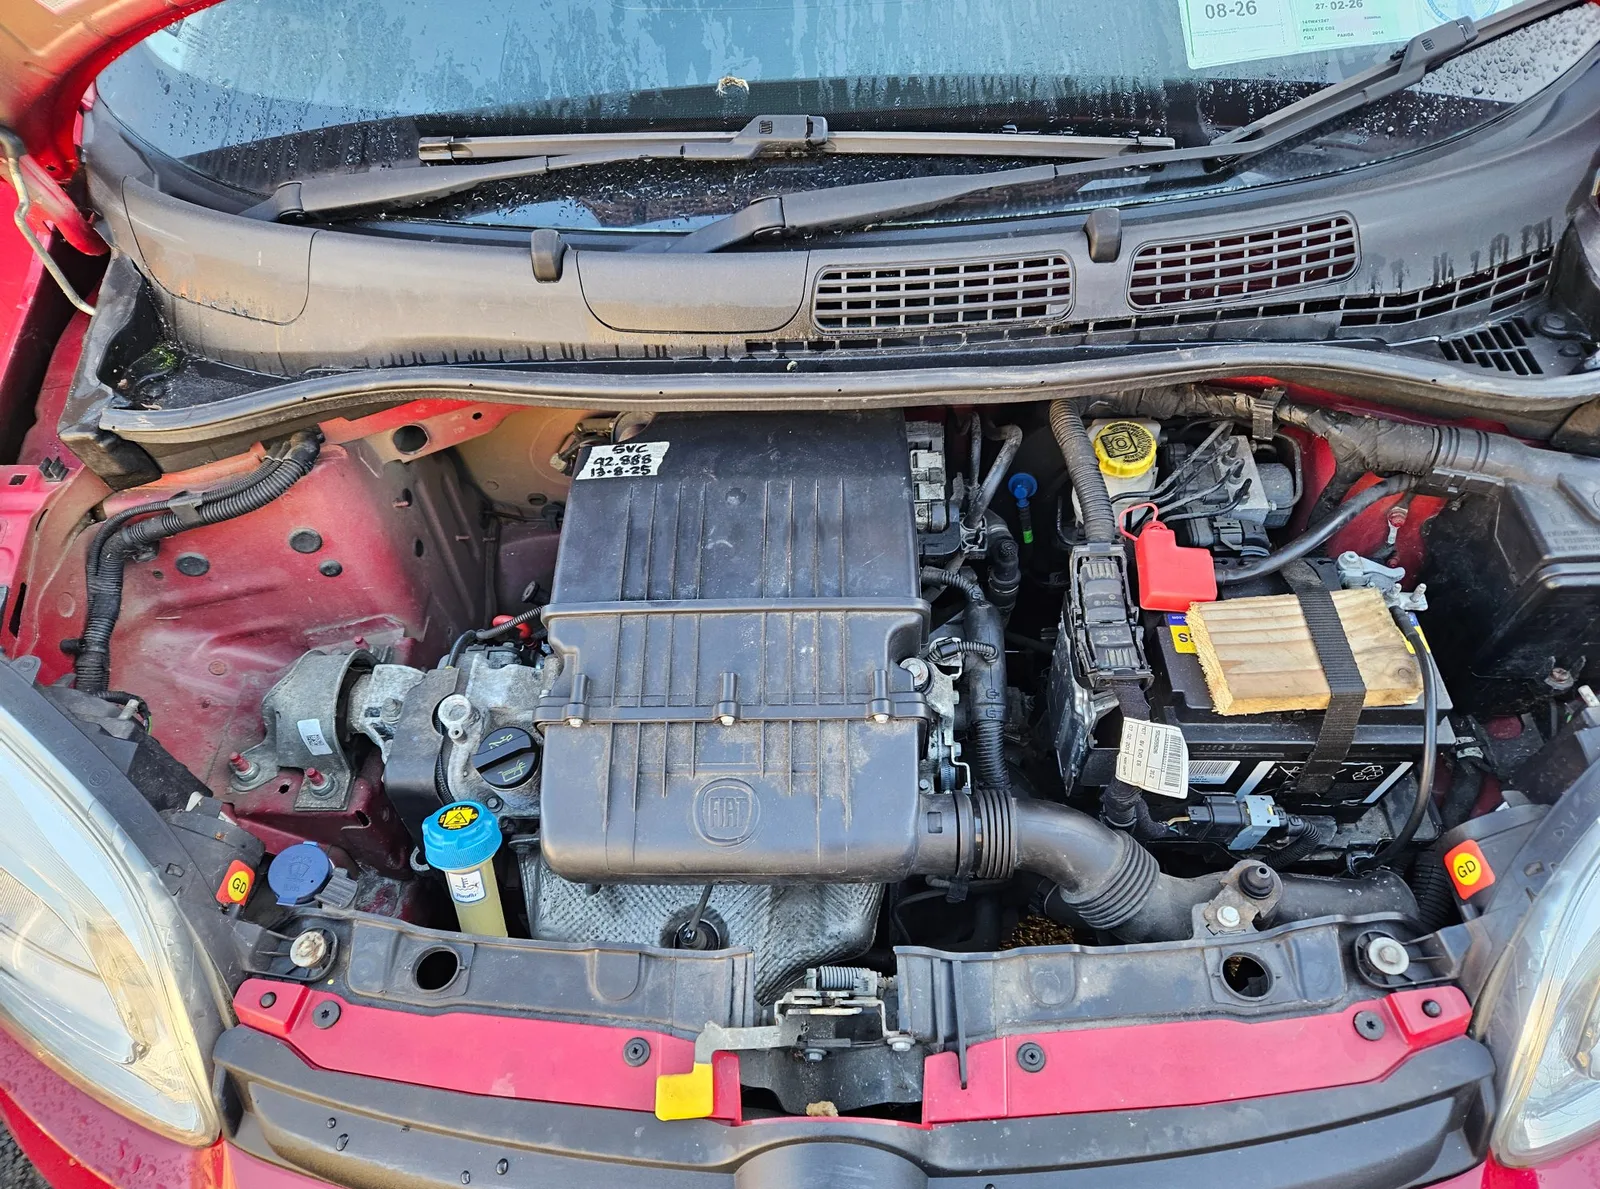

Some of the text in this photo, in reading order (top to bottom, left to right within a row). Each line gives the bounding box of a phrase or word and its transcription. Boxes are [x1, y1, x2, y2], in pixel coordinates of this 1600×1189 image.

[1205, 0, 1257, 19] 08-26
[612, 444, 649, 454] SVC
[709, 796, 747, 828] FIAT
[1457, 860, 1476, 878] GD
[232, 877, 247, 894] GD
